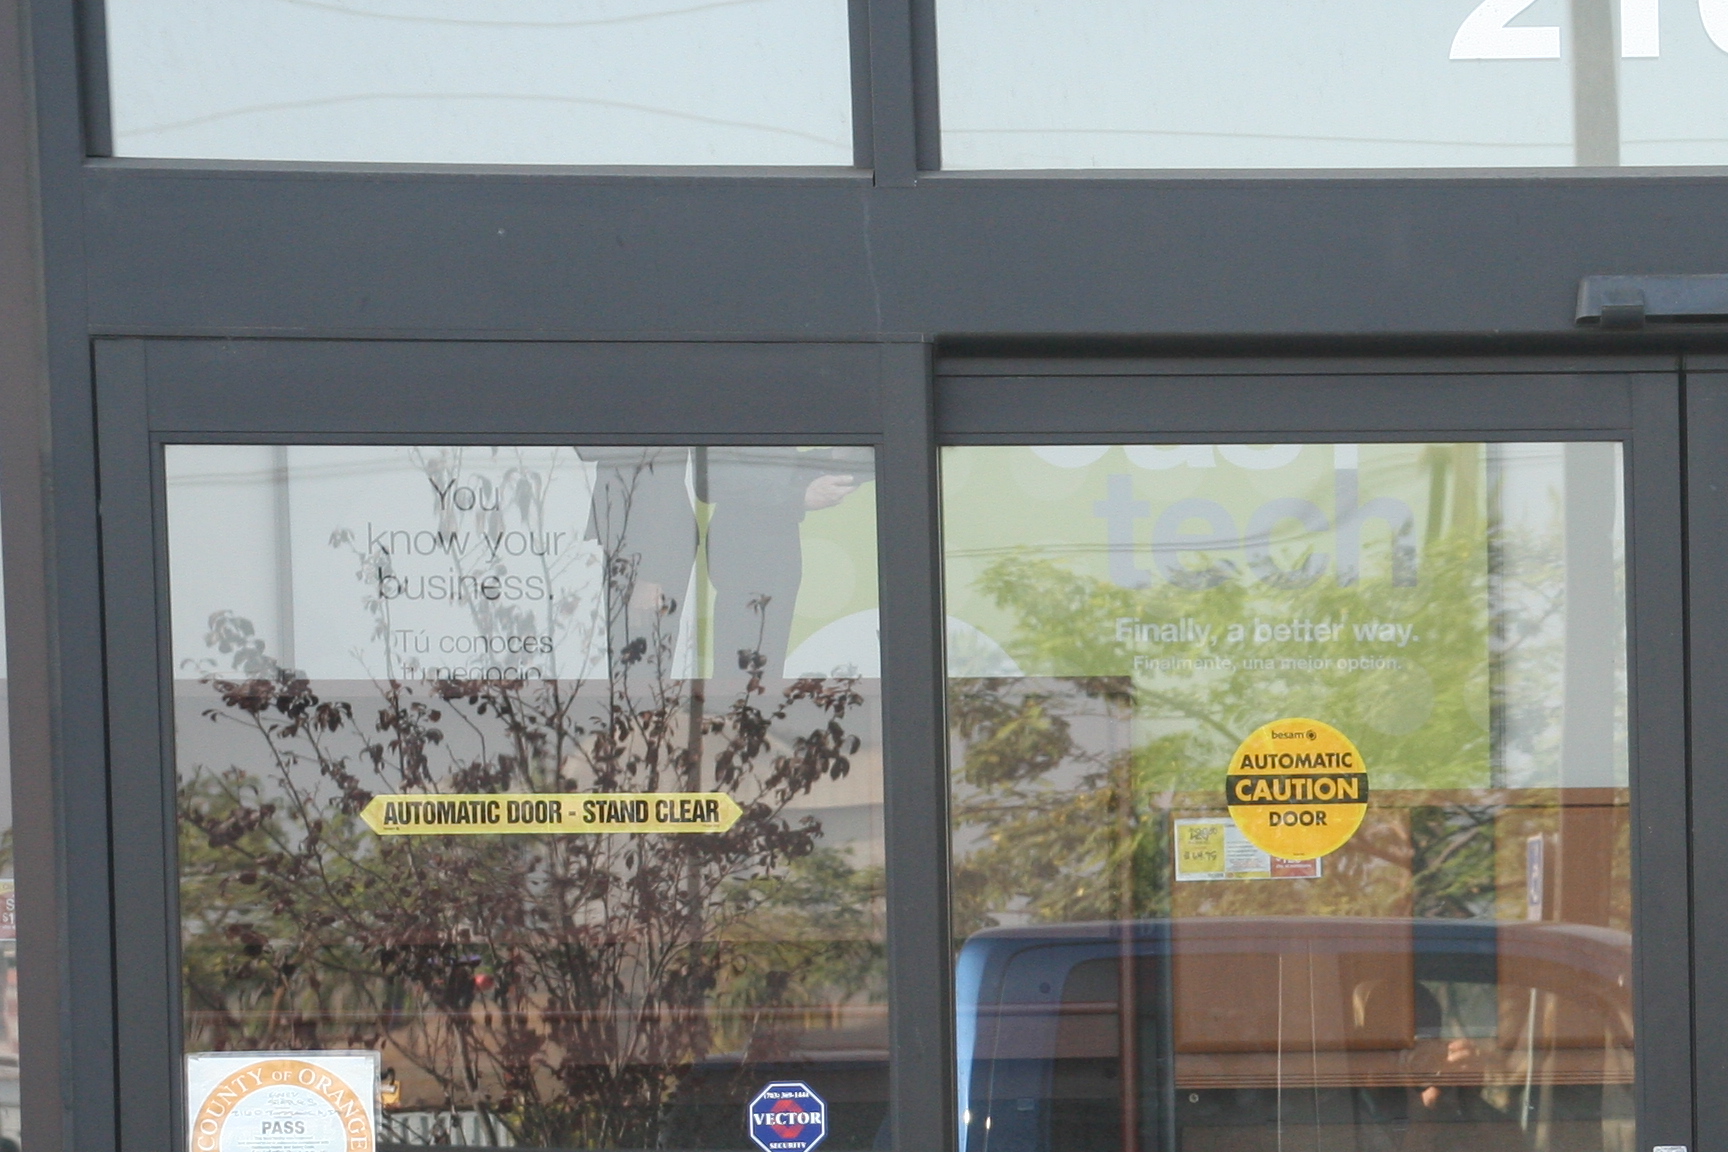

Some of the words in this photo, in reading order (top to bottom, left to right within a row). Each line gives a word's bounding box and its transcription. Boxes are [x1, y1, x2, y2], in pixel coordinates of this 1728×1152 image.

[429, 478, 500, 511] You
[1093, 469, 1418, 590] tech
[367, 522, 470, 555] know
[483, 530, 566, 563] your
[378, 566, 553, 600] business.
[395, 629, 430, 654] Tú
[439, 635, 553, 654] conoces
[1115, 617, 1217, 646] Finally,
[1227, 624, 1244, 643] a
[1254, 617, 1345, 643] better
[1352, 624, 1420, 648] way.
[1133, 656, 1237, 673] Finalmente,
[1243, 658, 1275, 671] una
[1281, 656, 1333, 673] mejor
[1336, 655, 1402, 674] opción.
[1272, 730, 1304, 740] besam
[1240, 753, 1352, 770] AUTOMATIC
[1235, 777, 1359, 802] CAUTION
[383, 800, 500, 825] AUTOMATIC
[507, 800, 562, 824] DOOR
[583, 799, 647, 823] STAND
[655, 799, 720, 823] CLEAR
[1269, 811, 1327, 827] DOOR
[198, 1068, 264, 1152] COUNTY
[272, 1070, 293, 1082] OF
[298, 1068, 368, 1150] ORANGE
[753, 1112, 821, 1125] VECTOR
[262, 1121, 305, 1135] PASS
